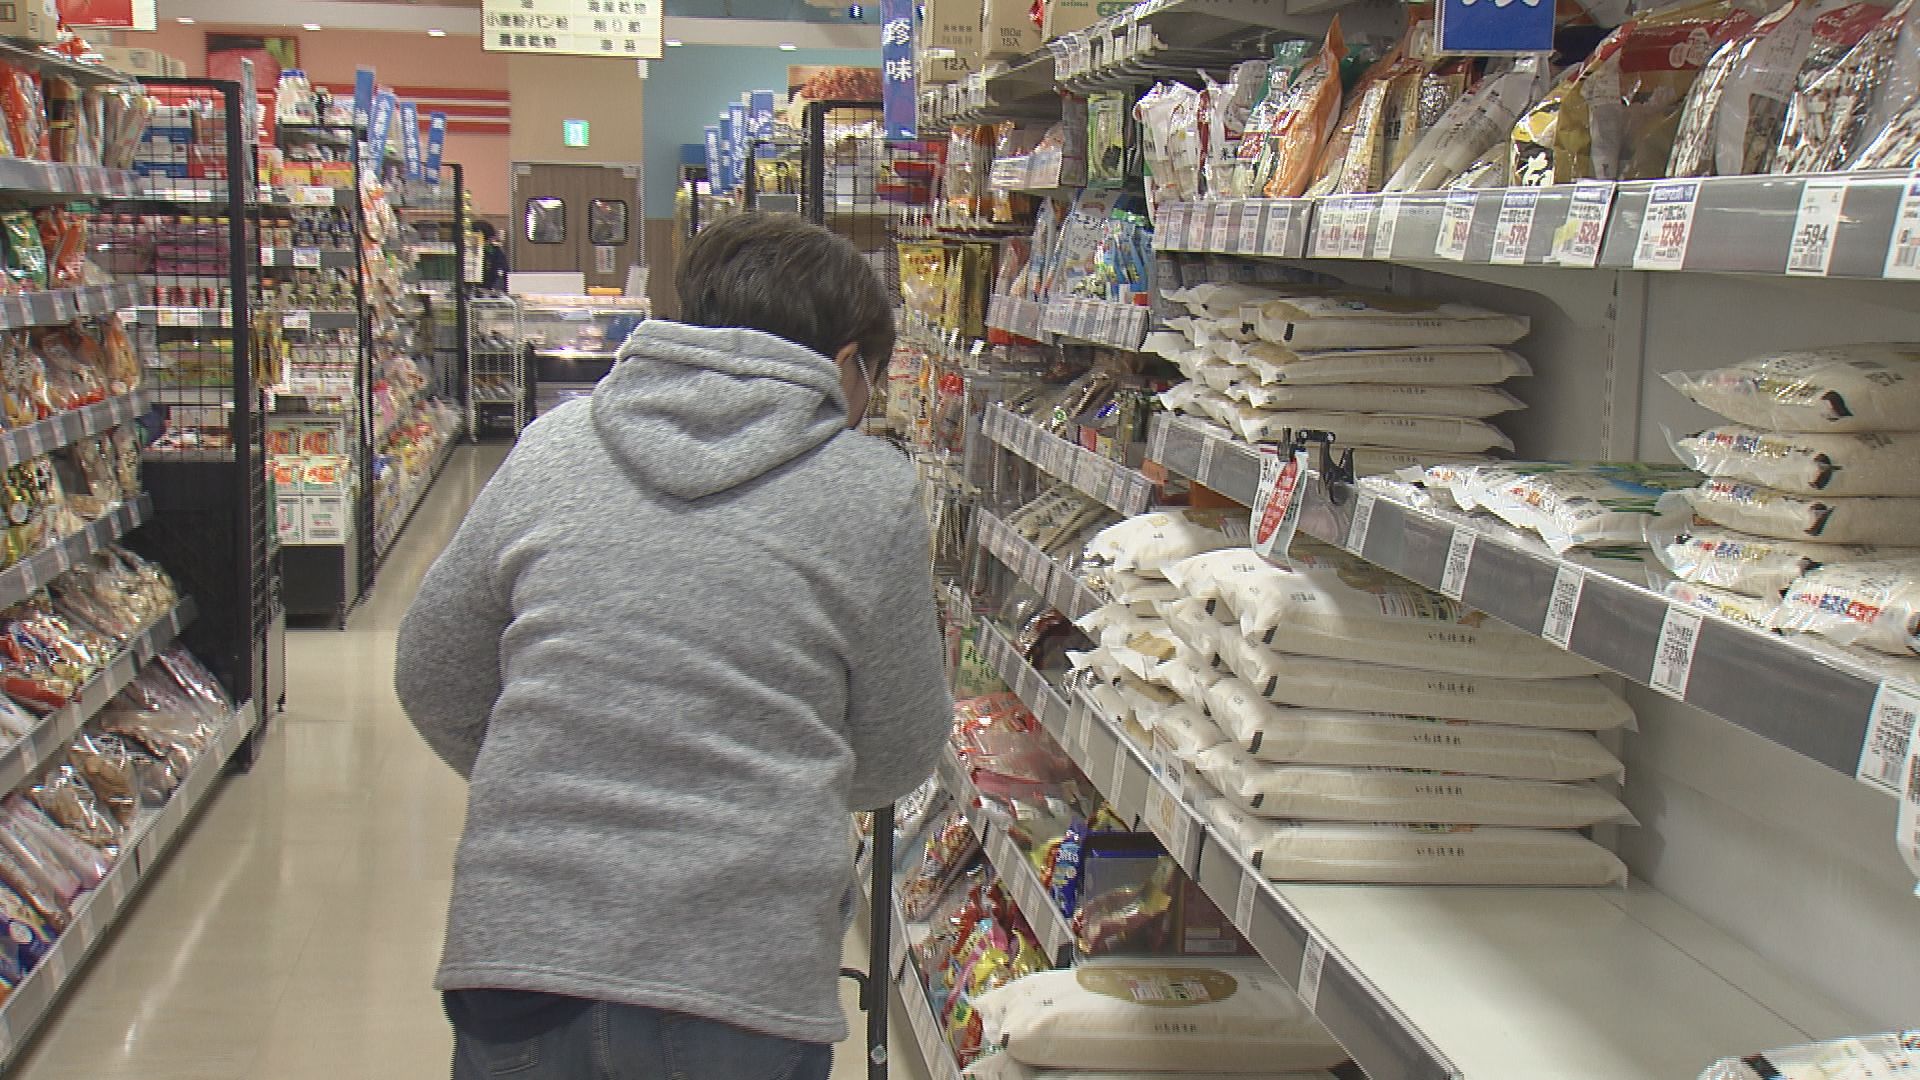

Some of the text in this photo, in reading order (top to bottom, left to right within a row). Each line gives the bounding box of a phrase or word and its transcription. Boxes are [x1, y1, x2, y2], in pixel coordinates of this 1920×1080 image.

[883, 18, 914, 82] 珍味
[1509, 225, 1527, 246] 578
[1578, 221, 1600, 245] 528
[1659, 221, 1685, 247] 1238
[1802, 223, 1829, 245] 594
